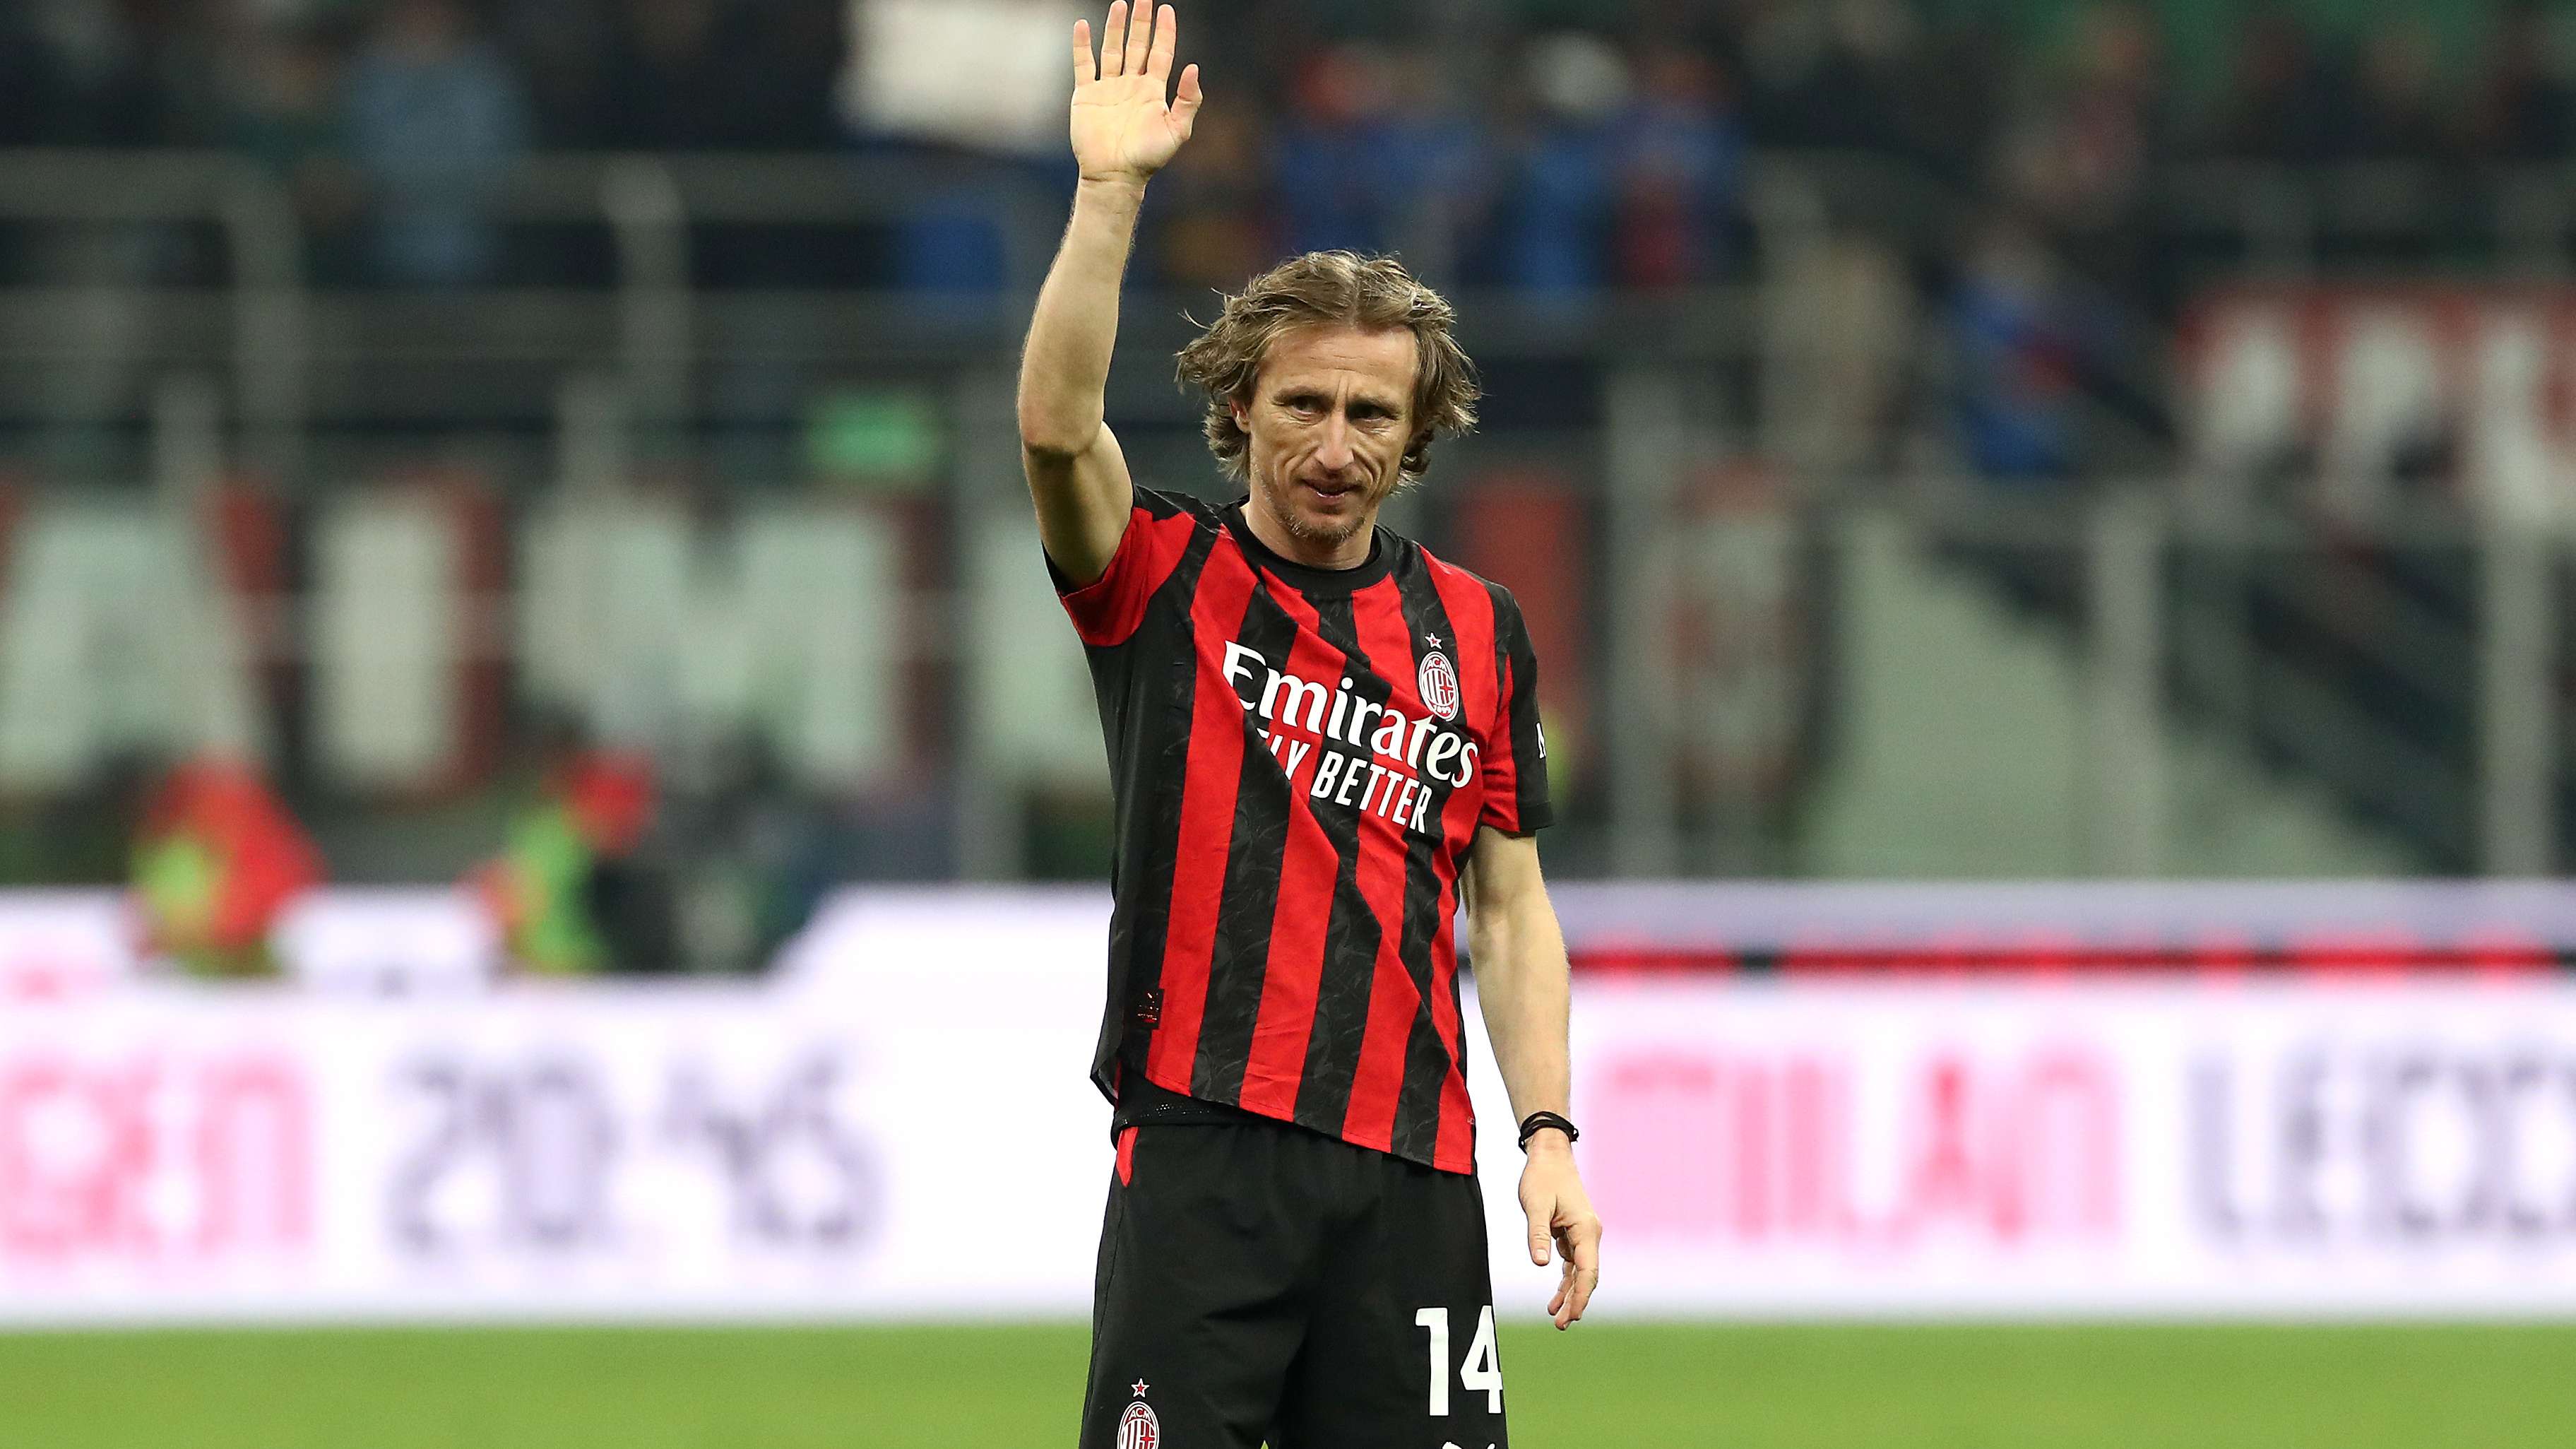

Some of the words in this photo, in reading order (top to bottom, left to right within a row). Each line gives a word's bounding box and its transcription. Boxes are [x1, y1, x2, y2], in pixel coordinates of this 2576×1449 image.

[1425, 657, 1447, 670] ACM
[1223, 639, 1478, 788] Emirates
[1311, 750, 1432, 834] BETTER
[1415, 1306, 1503, 1417] 14
[1128, 1407, 1151, 1421] ACM
